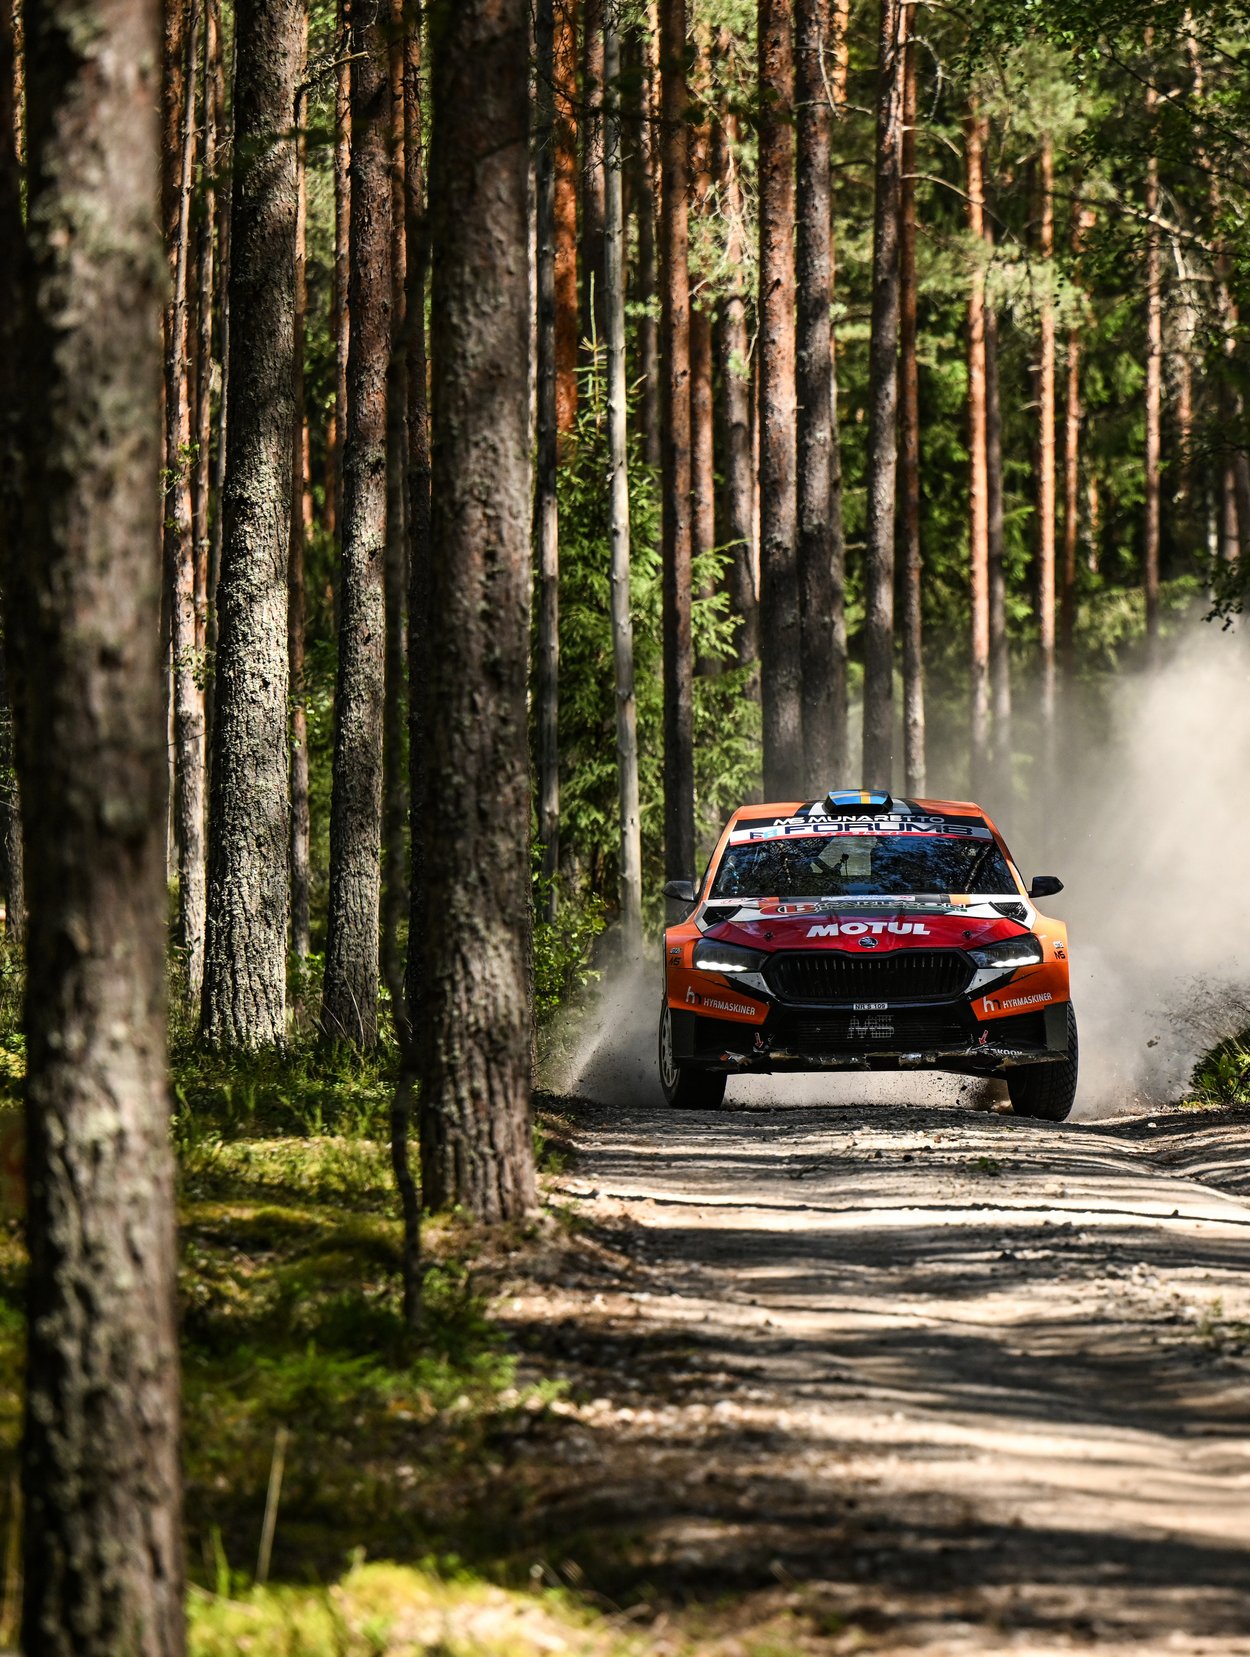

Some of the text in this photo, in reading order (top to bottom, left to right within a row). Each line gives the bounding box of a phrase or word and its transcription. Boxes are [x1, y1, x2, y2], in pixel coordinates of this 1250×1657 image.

[773, 814, 945, 826] MS MUNARETTO
[785, 822, 973, 835] FORUM8
[806, 921, 931, 938] MOTUL
[703, 997, 756, 1015] HYRMASKINER
[1002, 992, 1053, 1009] HYRMASKINER
